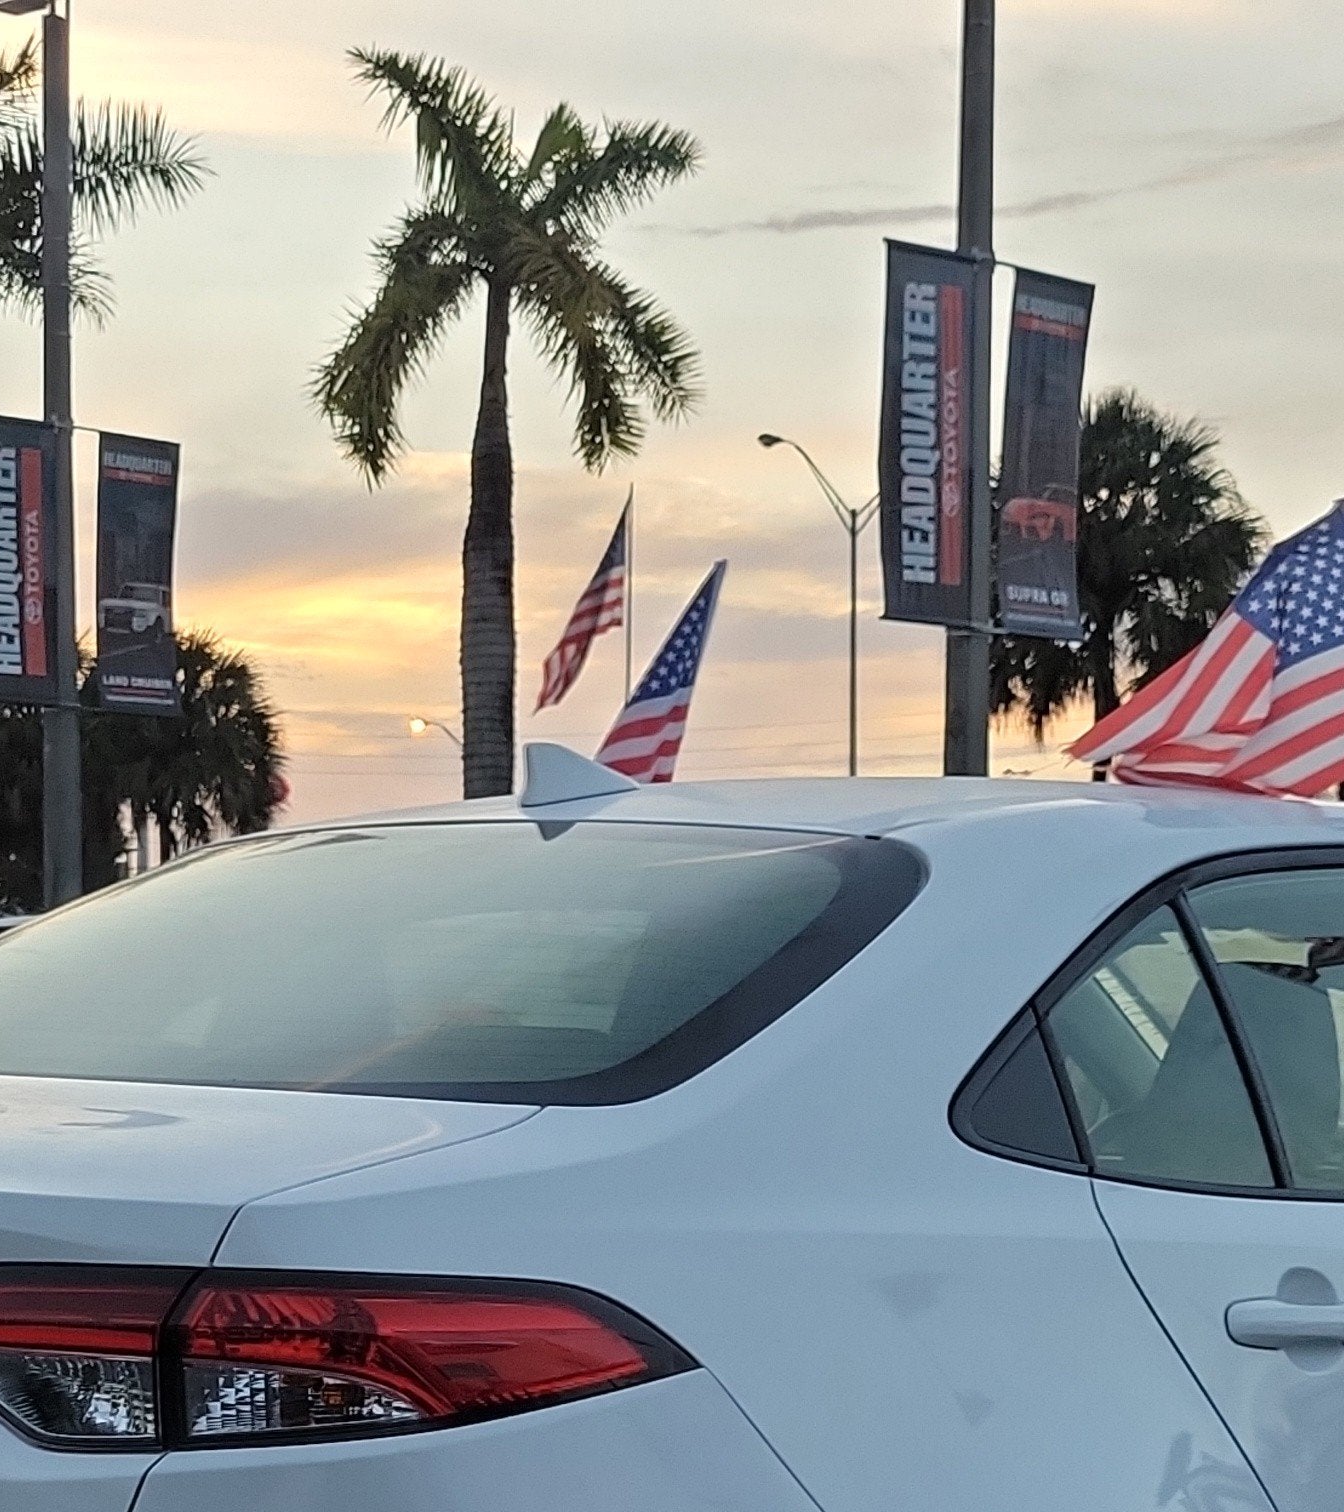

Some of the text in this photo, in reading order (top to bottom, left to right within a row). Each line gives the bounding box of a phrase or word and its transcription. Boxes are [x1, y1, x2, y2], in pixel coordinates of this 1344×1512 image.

[900, 282, 940, 585] HEADQUARTER
[941, 367, 961, 480] TOYOTA
[24, 508, 40, 597] TOYOTA
